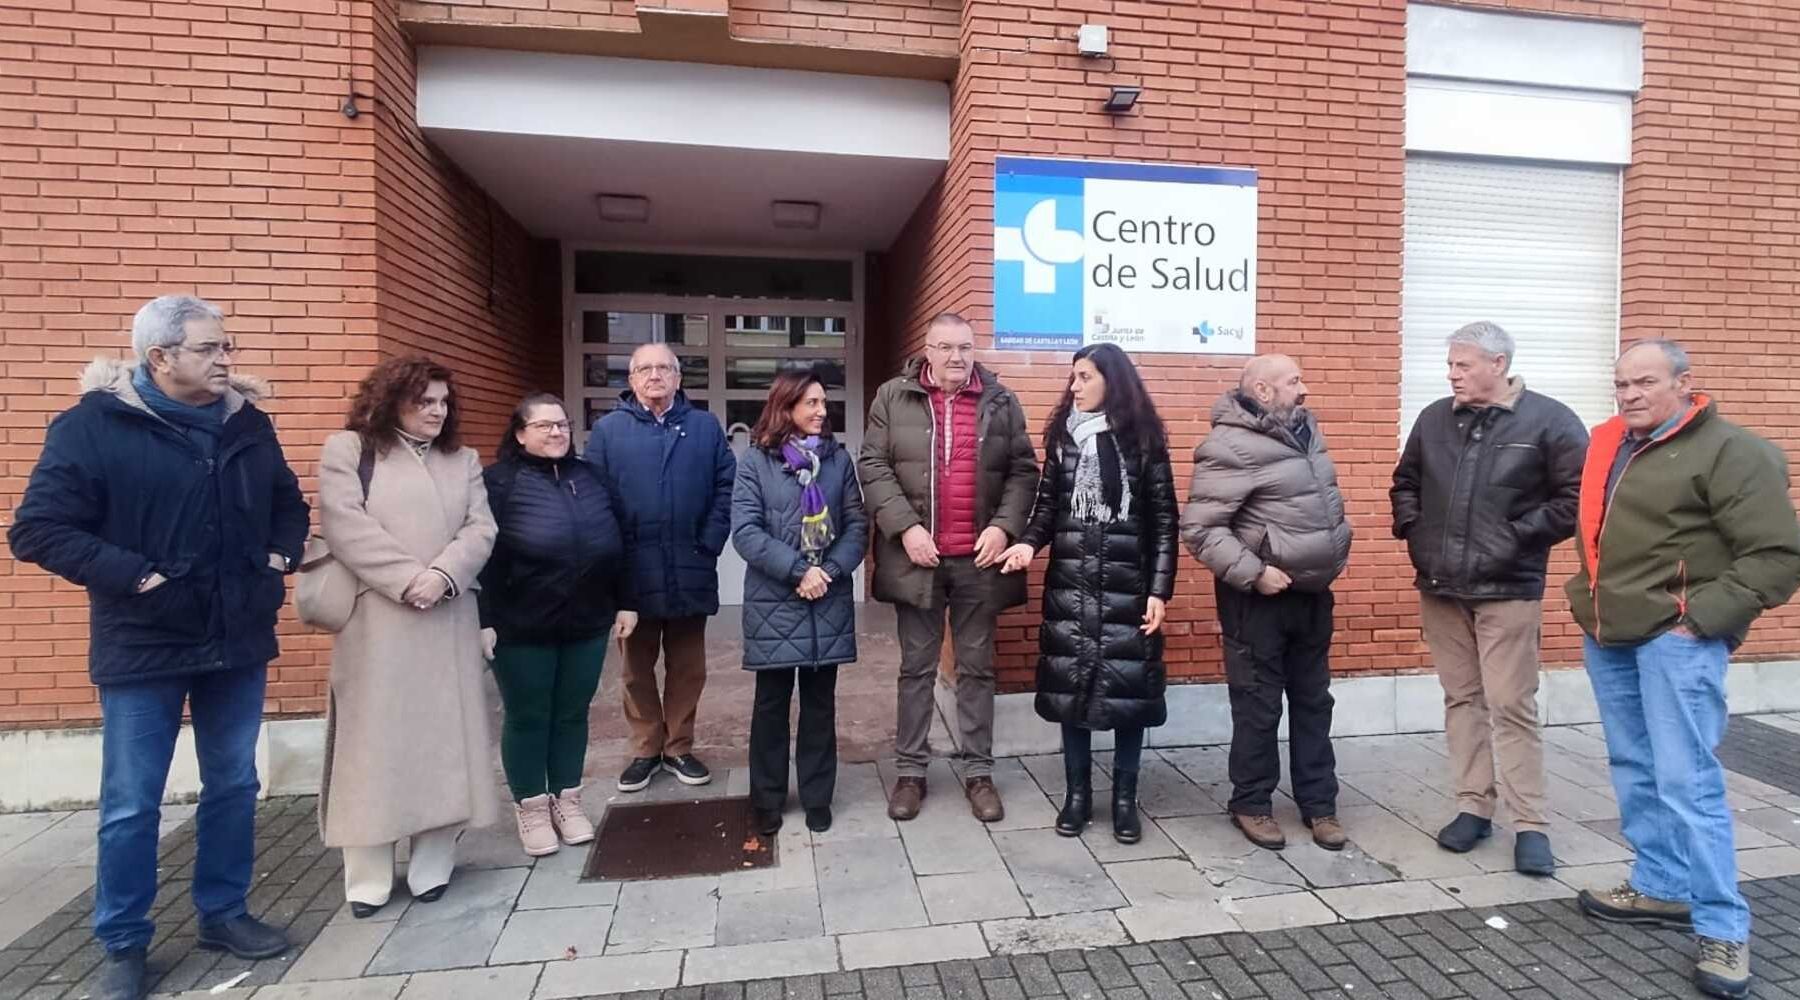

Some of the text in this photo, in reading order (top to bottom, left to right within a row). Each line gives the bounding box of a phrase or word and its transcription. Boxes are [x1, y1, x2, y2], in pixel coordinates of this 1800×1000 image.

[1092, 210, 1215, 246] Centro
[1092, 254, 1248, 292] de Salud
